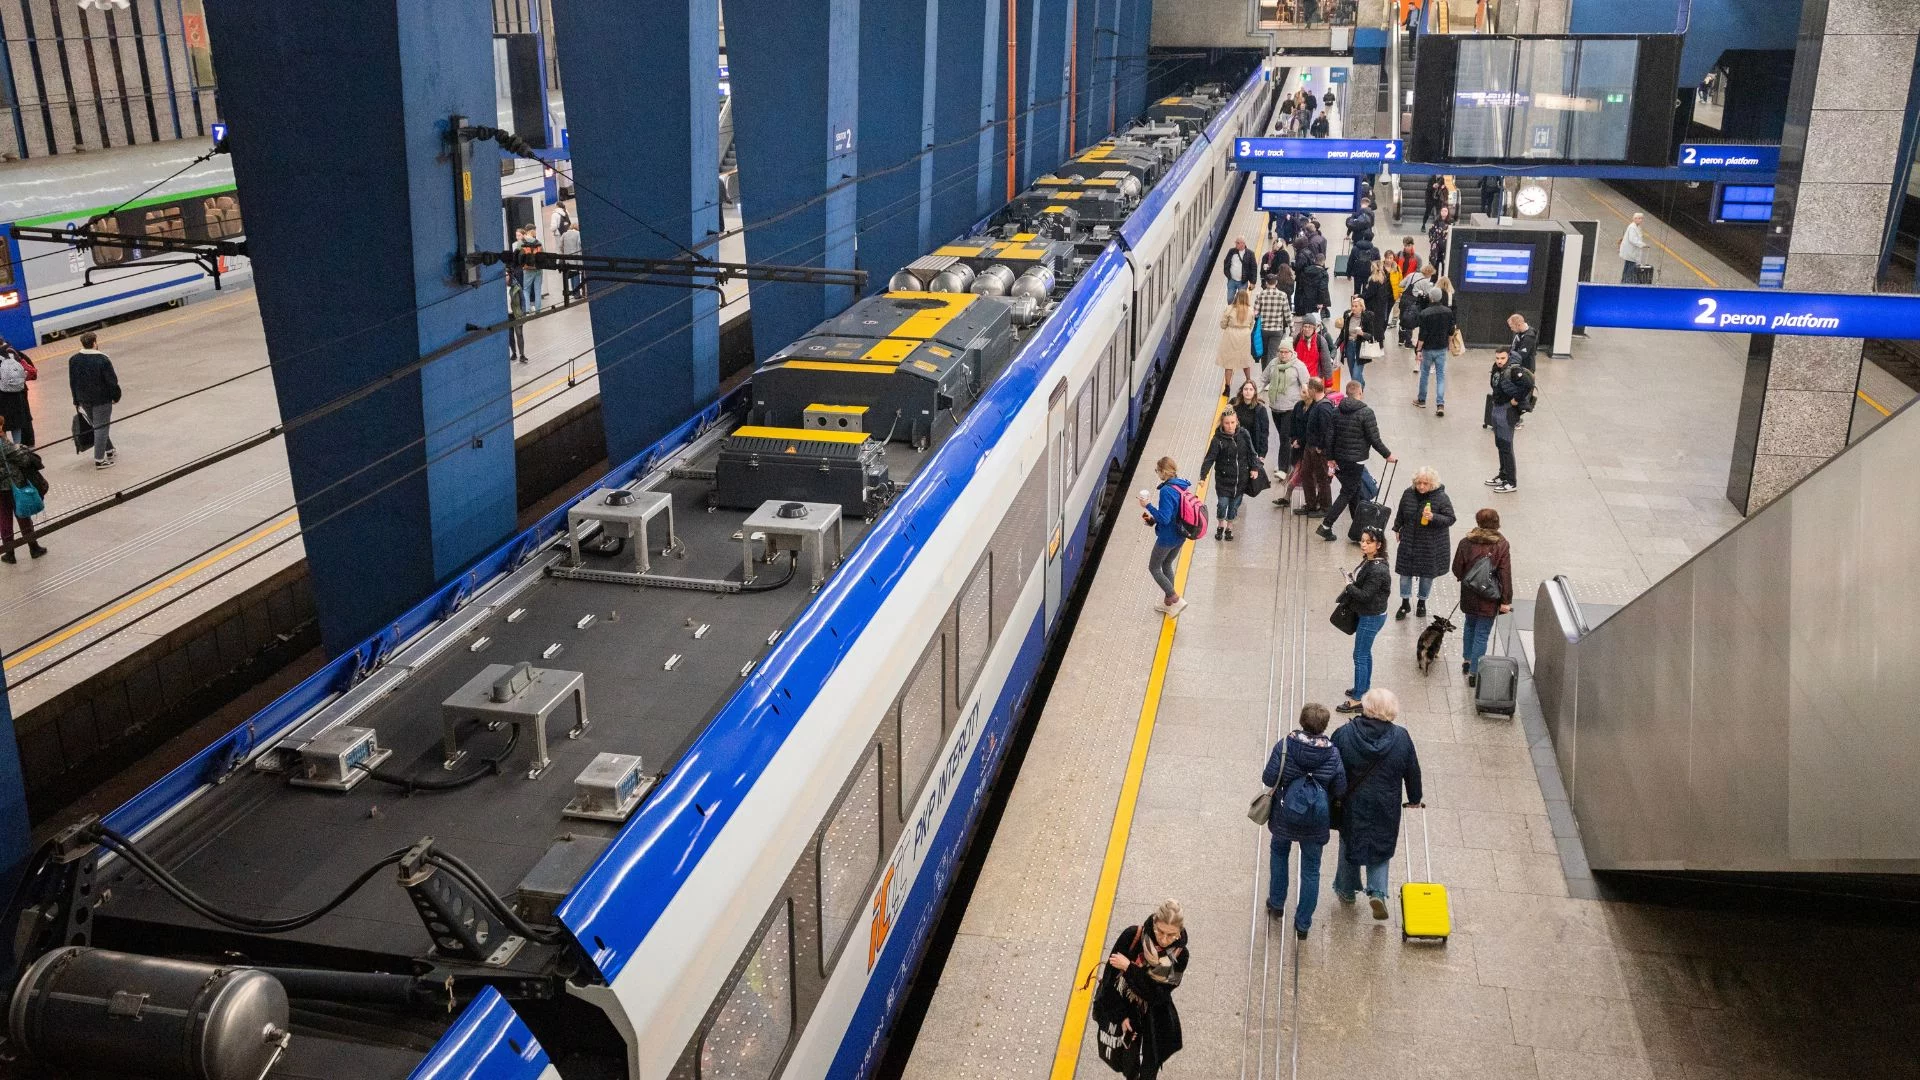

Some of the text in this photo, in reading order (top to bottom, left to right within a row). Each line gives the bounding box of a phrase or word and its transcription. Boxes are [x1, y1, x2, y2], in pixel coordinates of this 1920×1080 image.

[214, 126, 224, 140] 7
[847, 129, 851, 148] 2
[1240, 141, 1284, 157] 3 tor track
[1327, 143, 1396, 159] peron platform 2
[1683, 148, 1759, 166] 2 peron platform
[1695, 298, 1839, 329] 2 peron platform
[913, 789, 937, 861] PKP
[936, 693, 982, 811] INTERCITY
